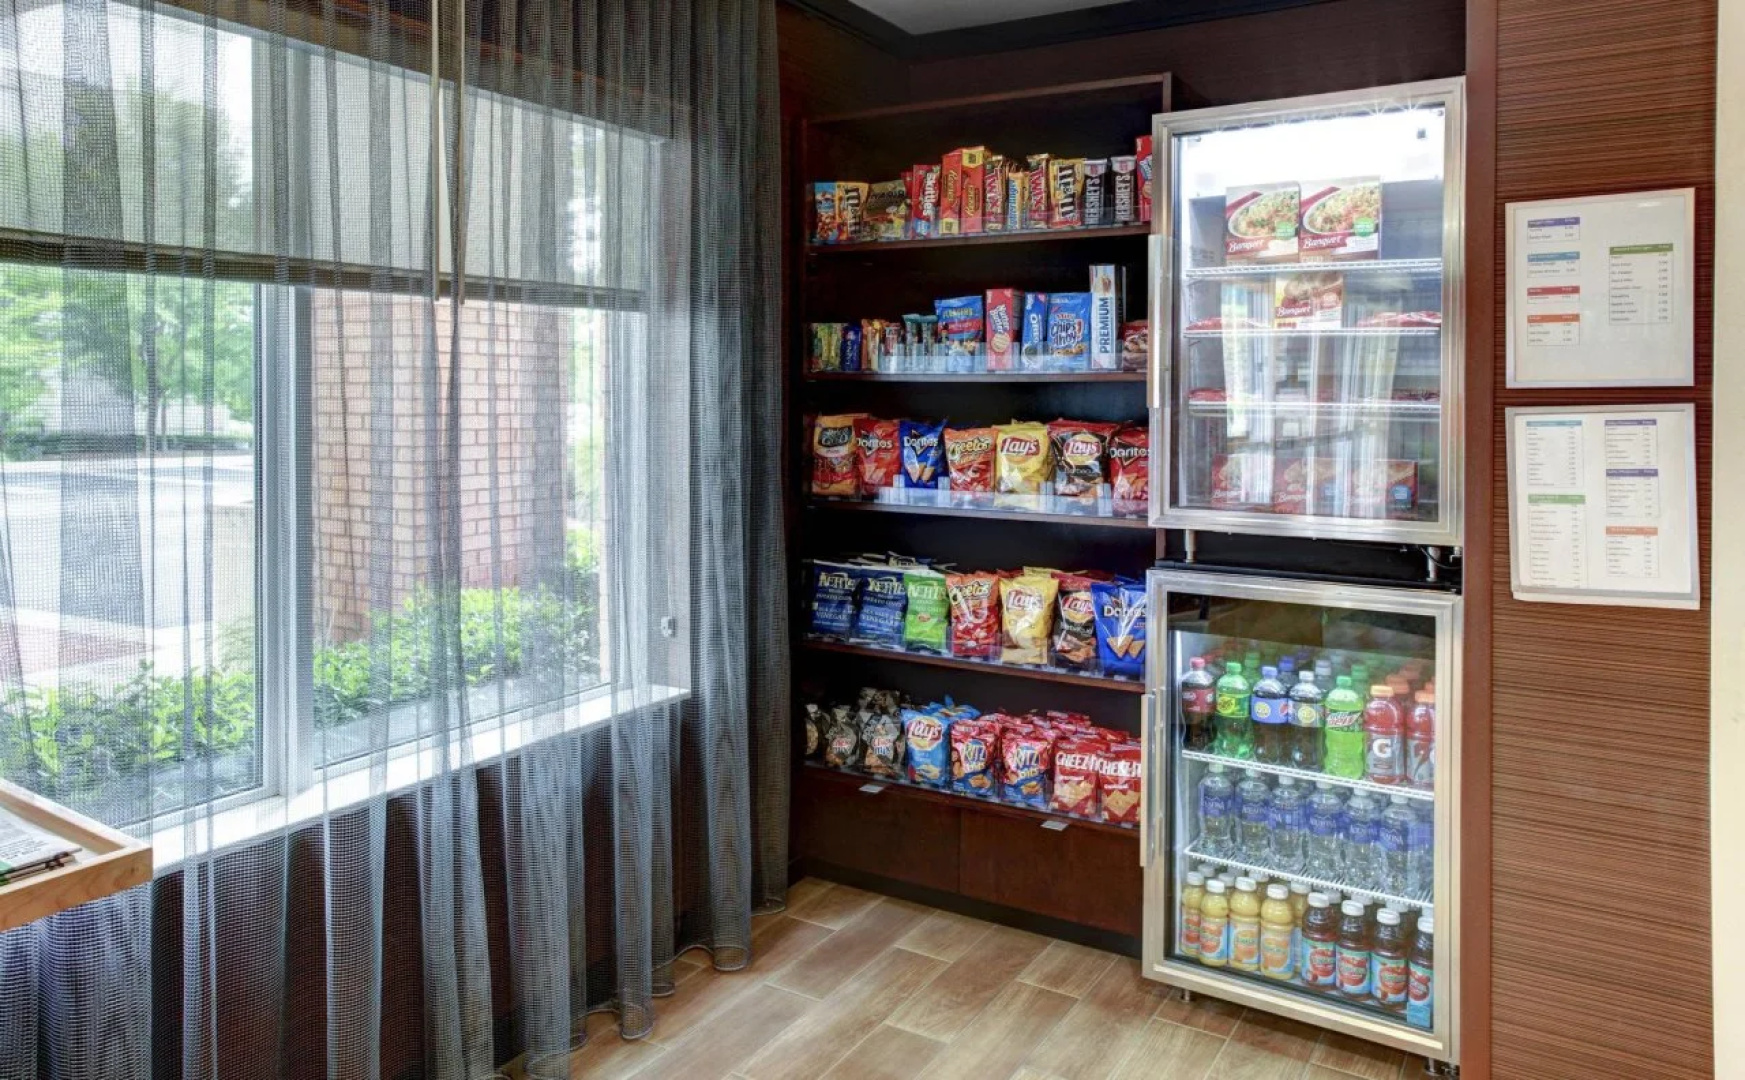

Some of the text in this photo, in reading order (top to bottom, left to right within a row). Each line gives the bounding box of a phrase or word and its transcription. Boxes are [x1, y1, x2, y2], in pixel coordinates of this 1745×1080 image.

[1115, 174, 1131, 220] HERSHEY'S
[1100, 297, 1111, 354] PREMIUM
[1372, 738, 1392, 758] G
